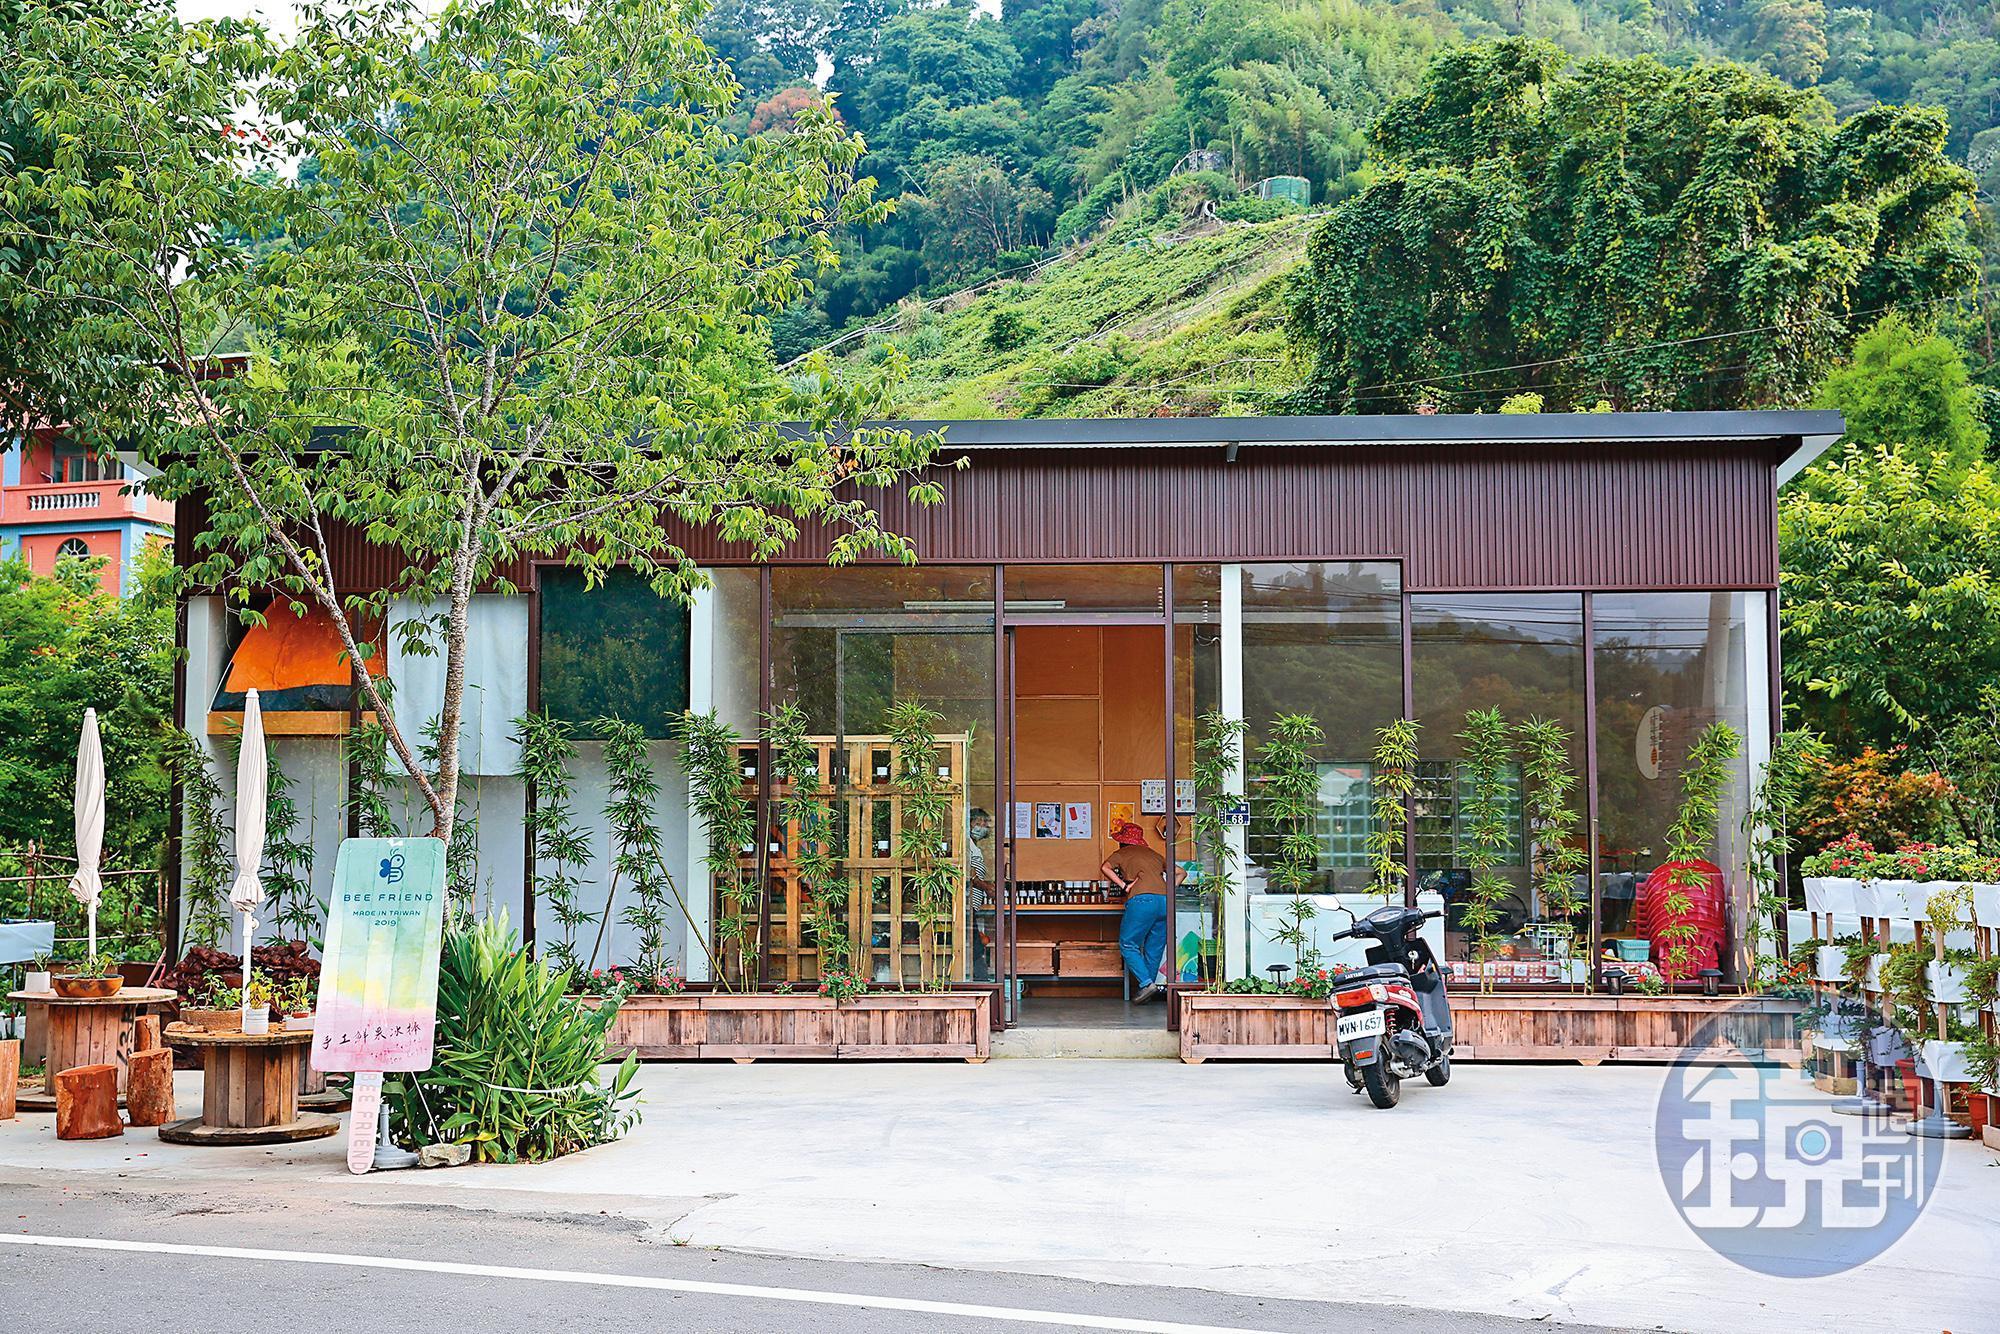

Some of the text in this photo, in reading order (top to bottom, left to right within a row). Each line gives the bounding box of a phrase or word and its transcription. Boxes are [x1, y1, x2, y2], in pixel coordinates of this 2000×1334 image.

[1231, 814, 1244, 825] 68
[343, 893, 434, 902] BEE FRIEND
[374, 919, 398, 927] 2019
[350, 1072, 378, 1171] BEE FRIEND
